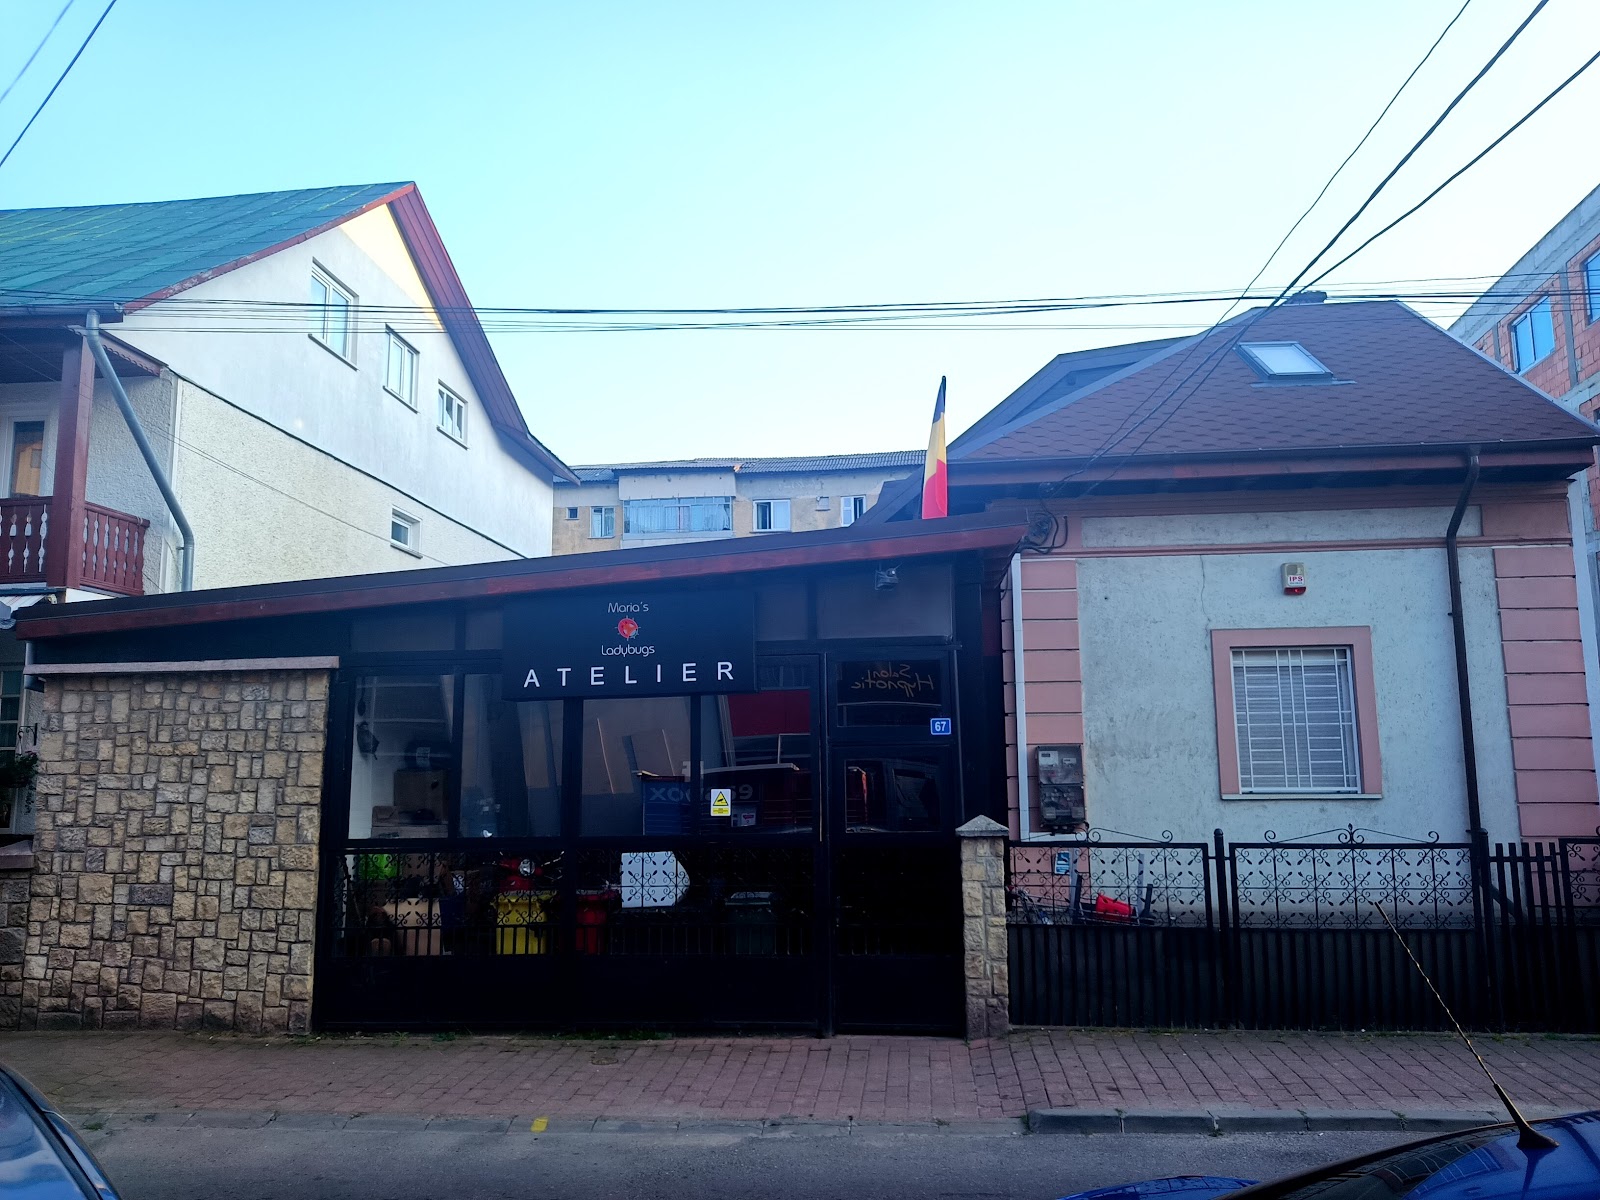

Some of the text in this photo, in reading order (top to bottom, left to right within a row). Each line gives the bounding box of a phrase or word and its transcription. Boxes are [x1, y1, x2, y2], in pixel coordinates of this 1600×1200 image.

[607, 602, 649, 613] Maria's
[601, 644, 655, 657] Ladybugs
[523, 661, 734, 688] ATELIER
[934, 721, 947, 732] 67
